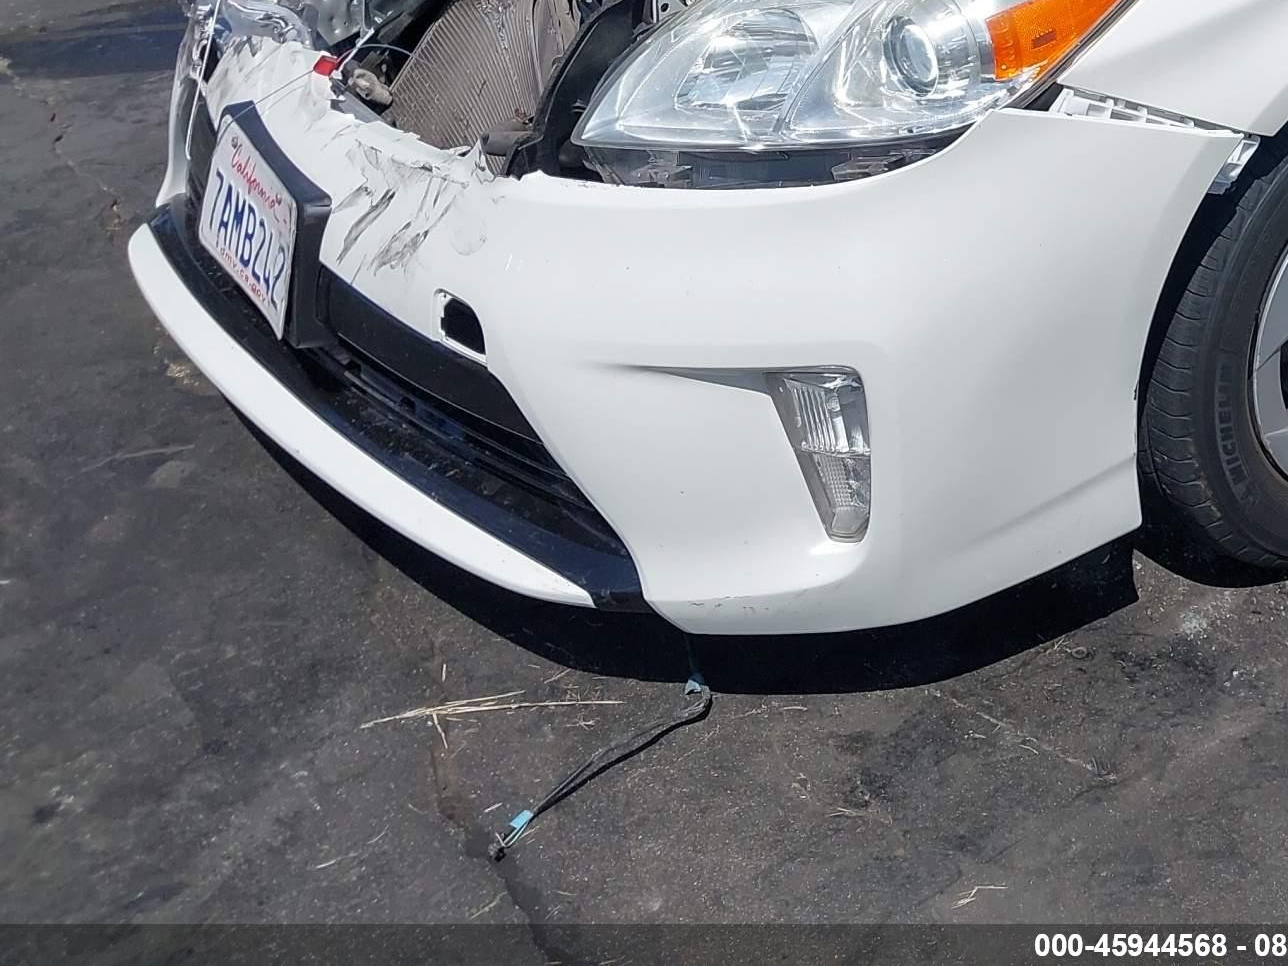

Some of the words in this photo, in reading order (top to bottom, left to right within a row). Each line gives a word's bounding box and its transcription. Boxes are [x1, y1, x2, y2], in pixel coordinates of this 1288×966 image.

[231, 144, 277, 210] California
[209, 167, 287, 312] 7AMB242
[219, 246, 267, 304] dmv.ca.gov
[1215, 360, 1248, 486] MICHELIN
